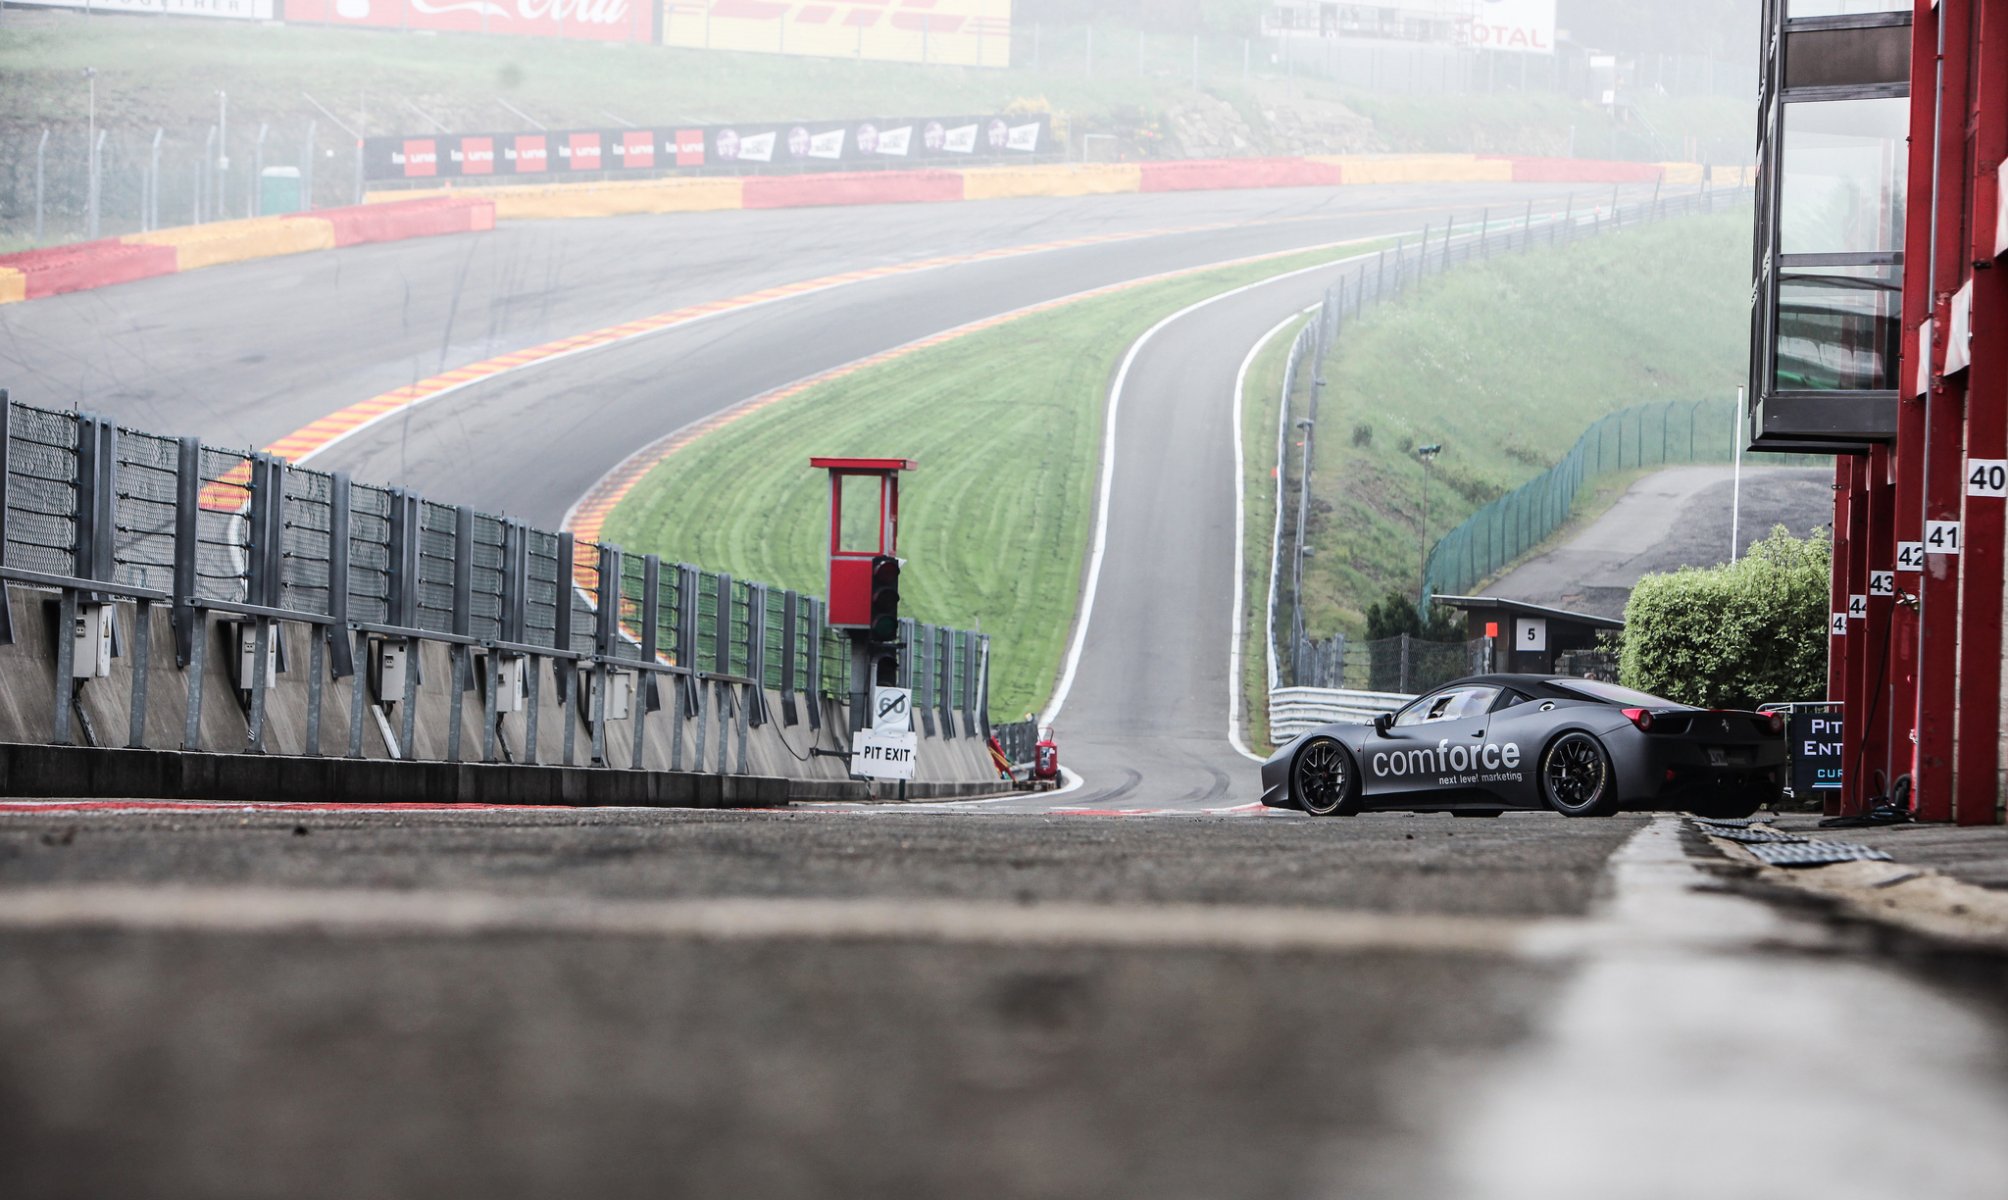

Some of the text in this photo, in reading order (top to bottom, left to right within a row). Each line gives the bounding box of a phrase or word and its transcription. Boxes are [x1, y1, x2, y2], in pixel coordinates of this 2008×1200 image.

[1970, 465, 2005, 490] 40
[1929, 526, 1957, 548] 41
[1899, 547, 1923, 566] 42
[1871, 575, 1893, 592] 43
[1833, 617, 1846, 630] 4
[1527, 627, 1535, 640] 5
[879, 697, 905, 714] 60
[1812, 719, 1843, 734] PIT
[864, 746, 910, 761] PIT EXIT
[1373, 738, 1521, 777] comforce
[1439, 771, 1523, 785] next level marketing
